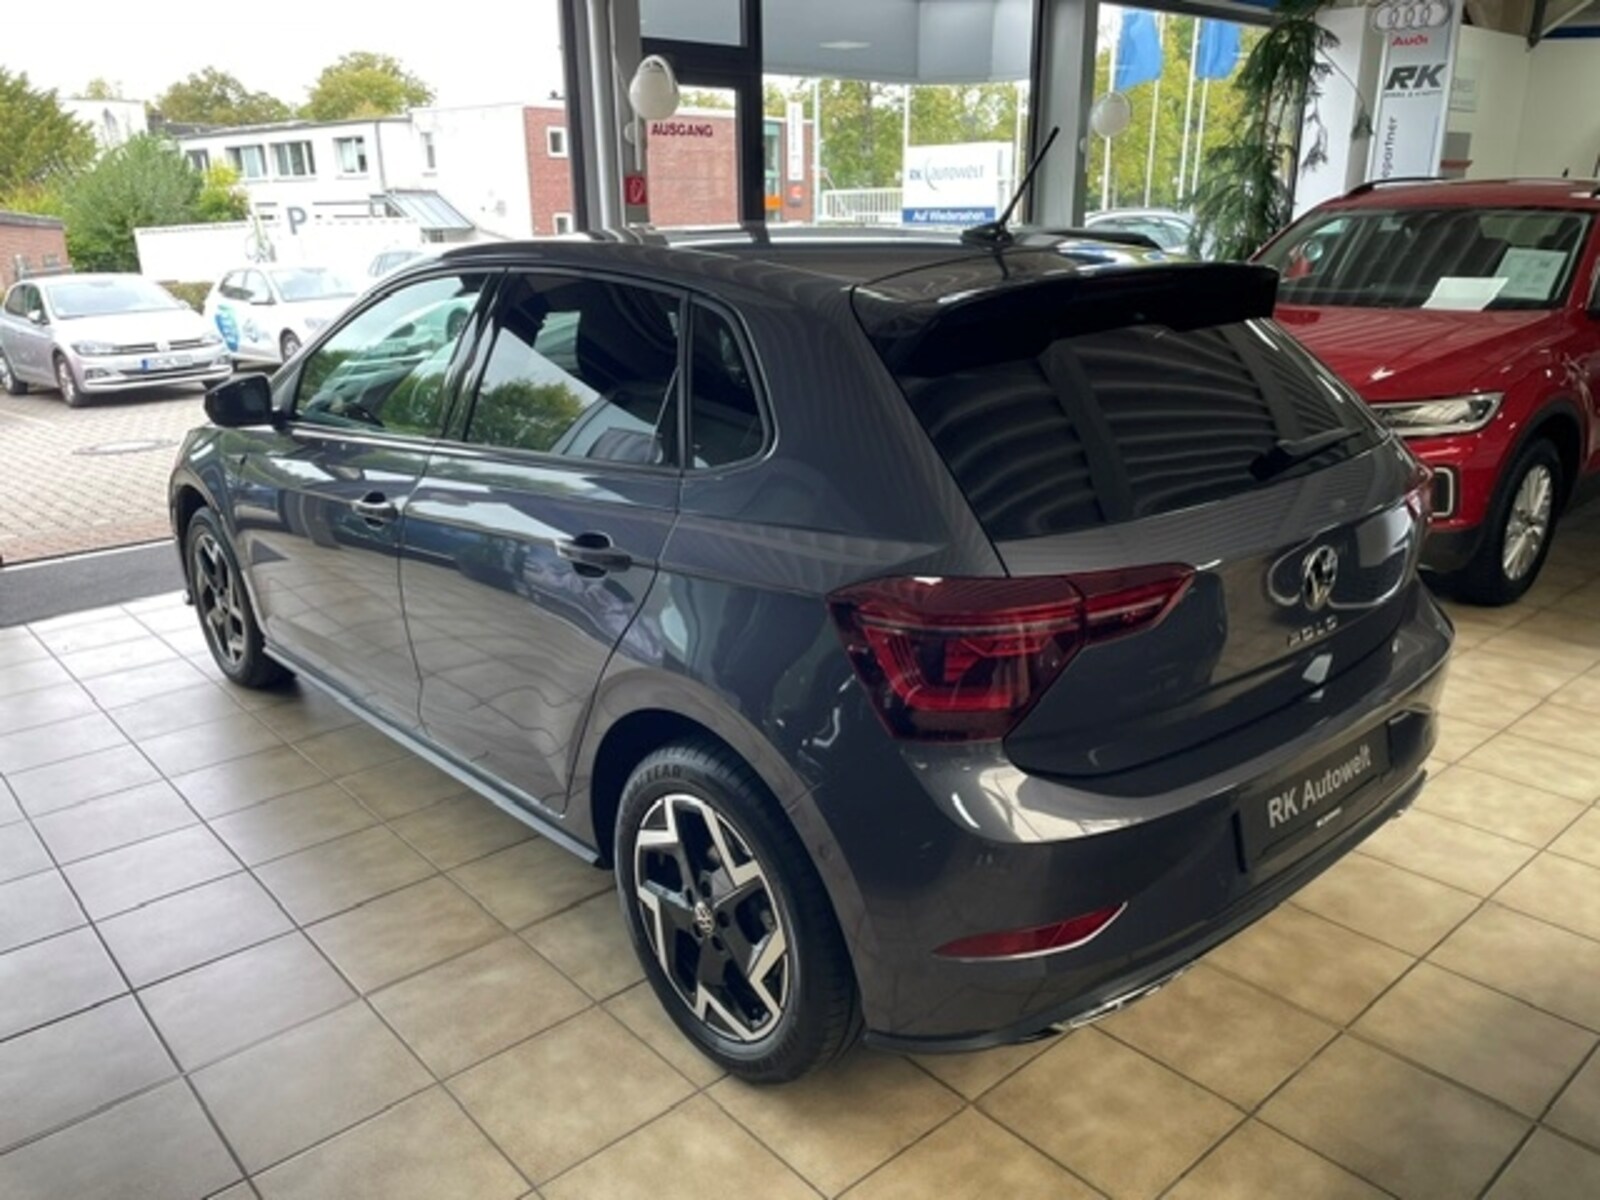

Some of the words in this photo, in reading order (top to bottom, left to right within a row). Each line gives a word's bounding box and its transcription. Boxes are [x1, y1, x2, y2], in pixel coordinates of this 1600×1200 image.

[1392, 35, 1429, 47] Audi
[1385, 64, 1447, 90] RK
[651, 122, 714, 138] AUSGANG
[286, 206, 308, 236] P
[1267, 787, 1299, 829] RK
[1302, 744, 1371, 811] Autowelt
